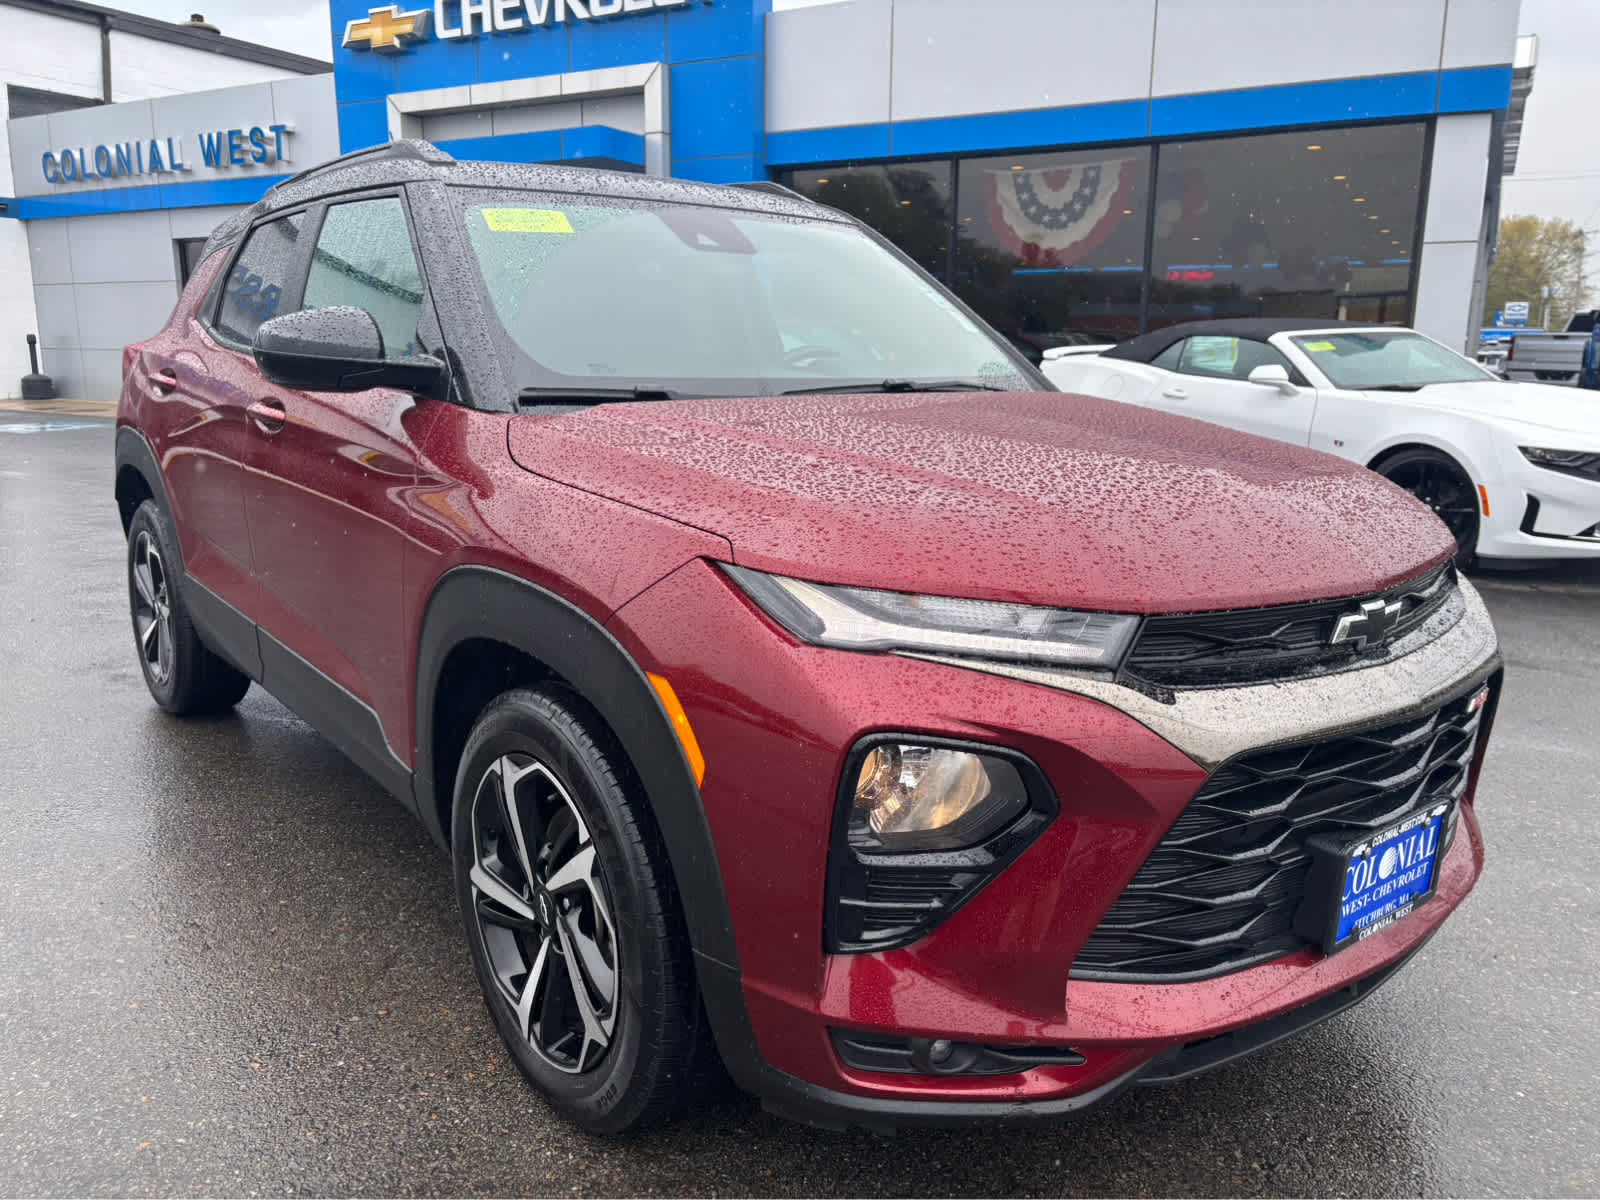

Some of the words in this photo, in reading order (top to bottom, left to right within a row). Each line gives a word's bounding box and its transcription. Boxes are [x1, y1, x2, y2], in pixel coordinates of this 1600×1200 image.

[41, 137, 186, 184] COLONIAL
[197, 123, 288, 168] WEST
[1372, 860, 1430, 902] CHEVROLET
[1395, 903, 1415, 920] WEST
